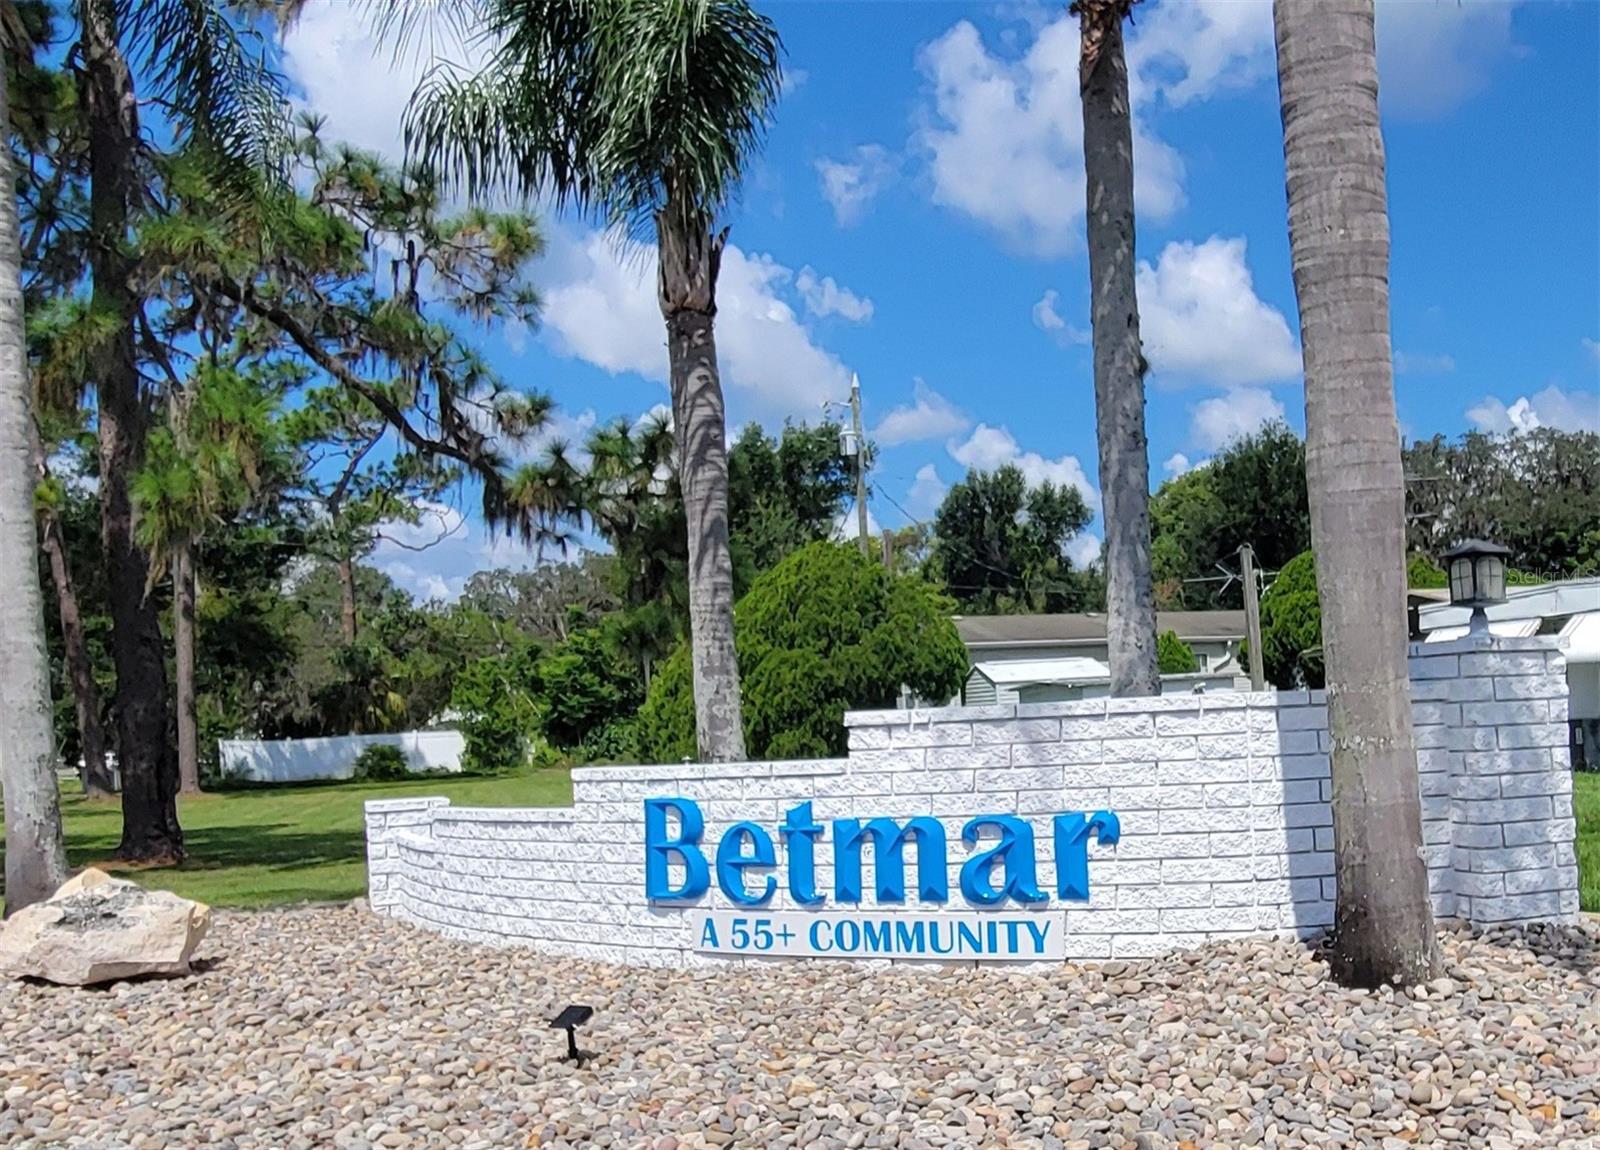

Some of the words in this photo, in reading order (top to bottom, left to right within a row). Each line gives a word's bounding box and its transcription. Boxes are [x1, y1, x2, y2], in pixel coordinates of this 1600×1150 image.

[644, 796, 1120, 908] Betmar
[701, 917, 720, 949] A
[731, 918, 796, 951] 55+
[810, 920, 1051, 955] COMMUNITY
